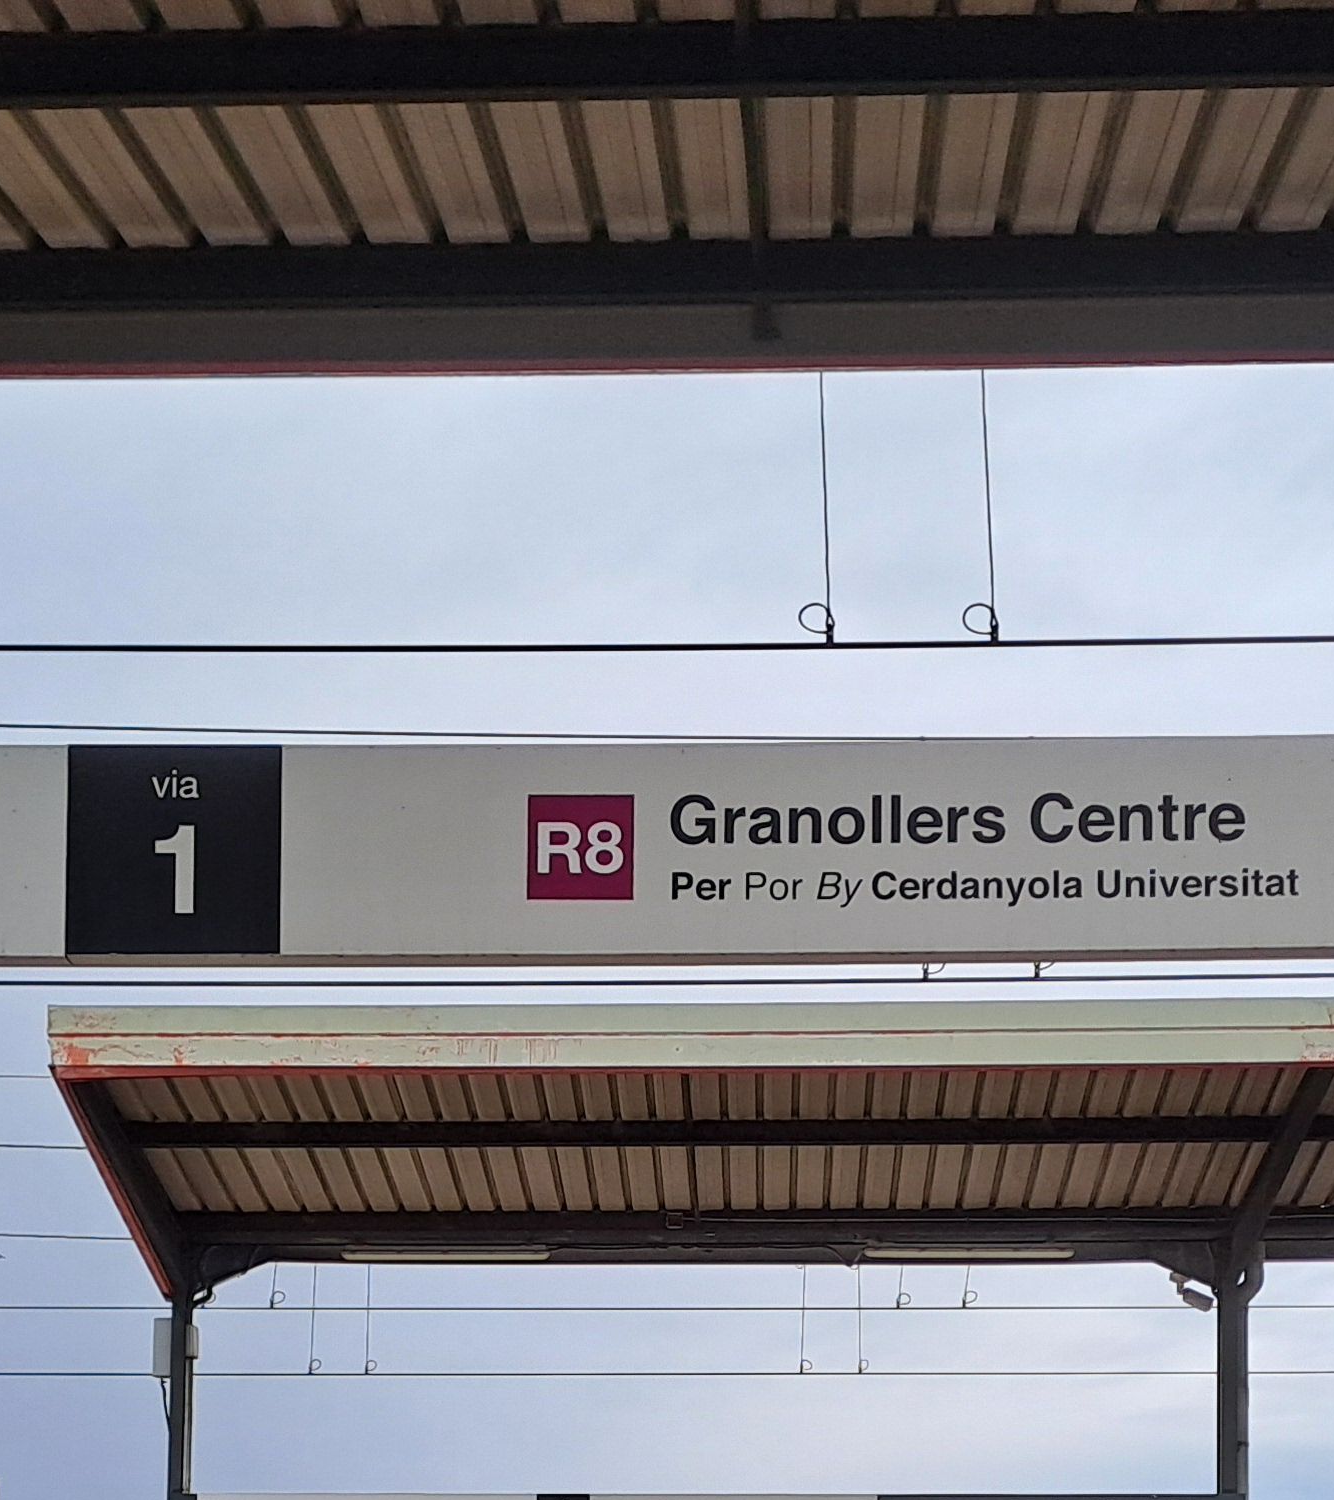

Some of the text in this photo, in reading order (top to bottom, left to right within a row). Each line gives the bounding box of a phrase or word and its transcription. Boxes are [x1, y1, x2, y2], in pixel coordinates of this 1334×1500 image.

[151, 769, 199, 799] via
[669, 792, 1246, 846] Granollers Centre
[154, 825, 196, 914] 1
[536, 820, 625, 875] R8
[671, 867, 1300, 909] Per Por By Cerdanyola Universitat
